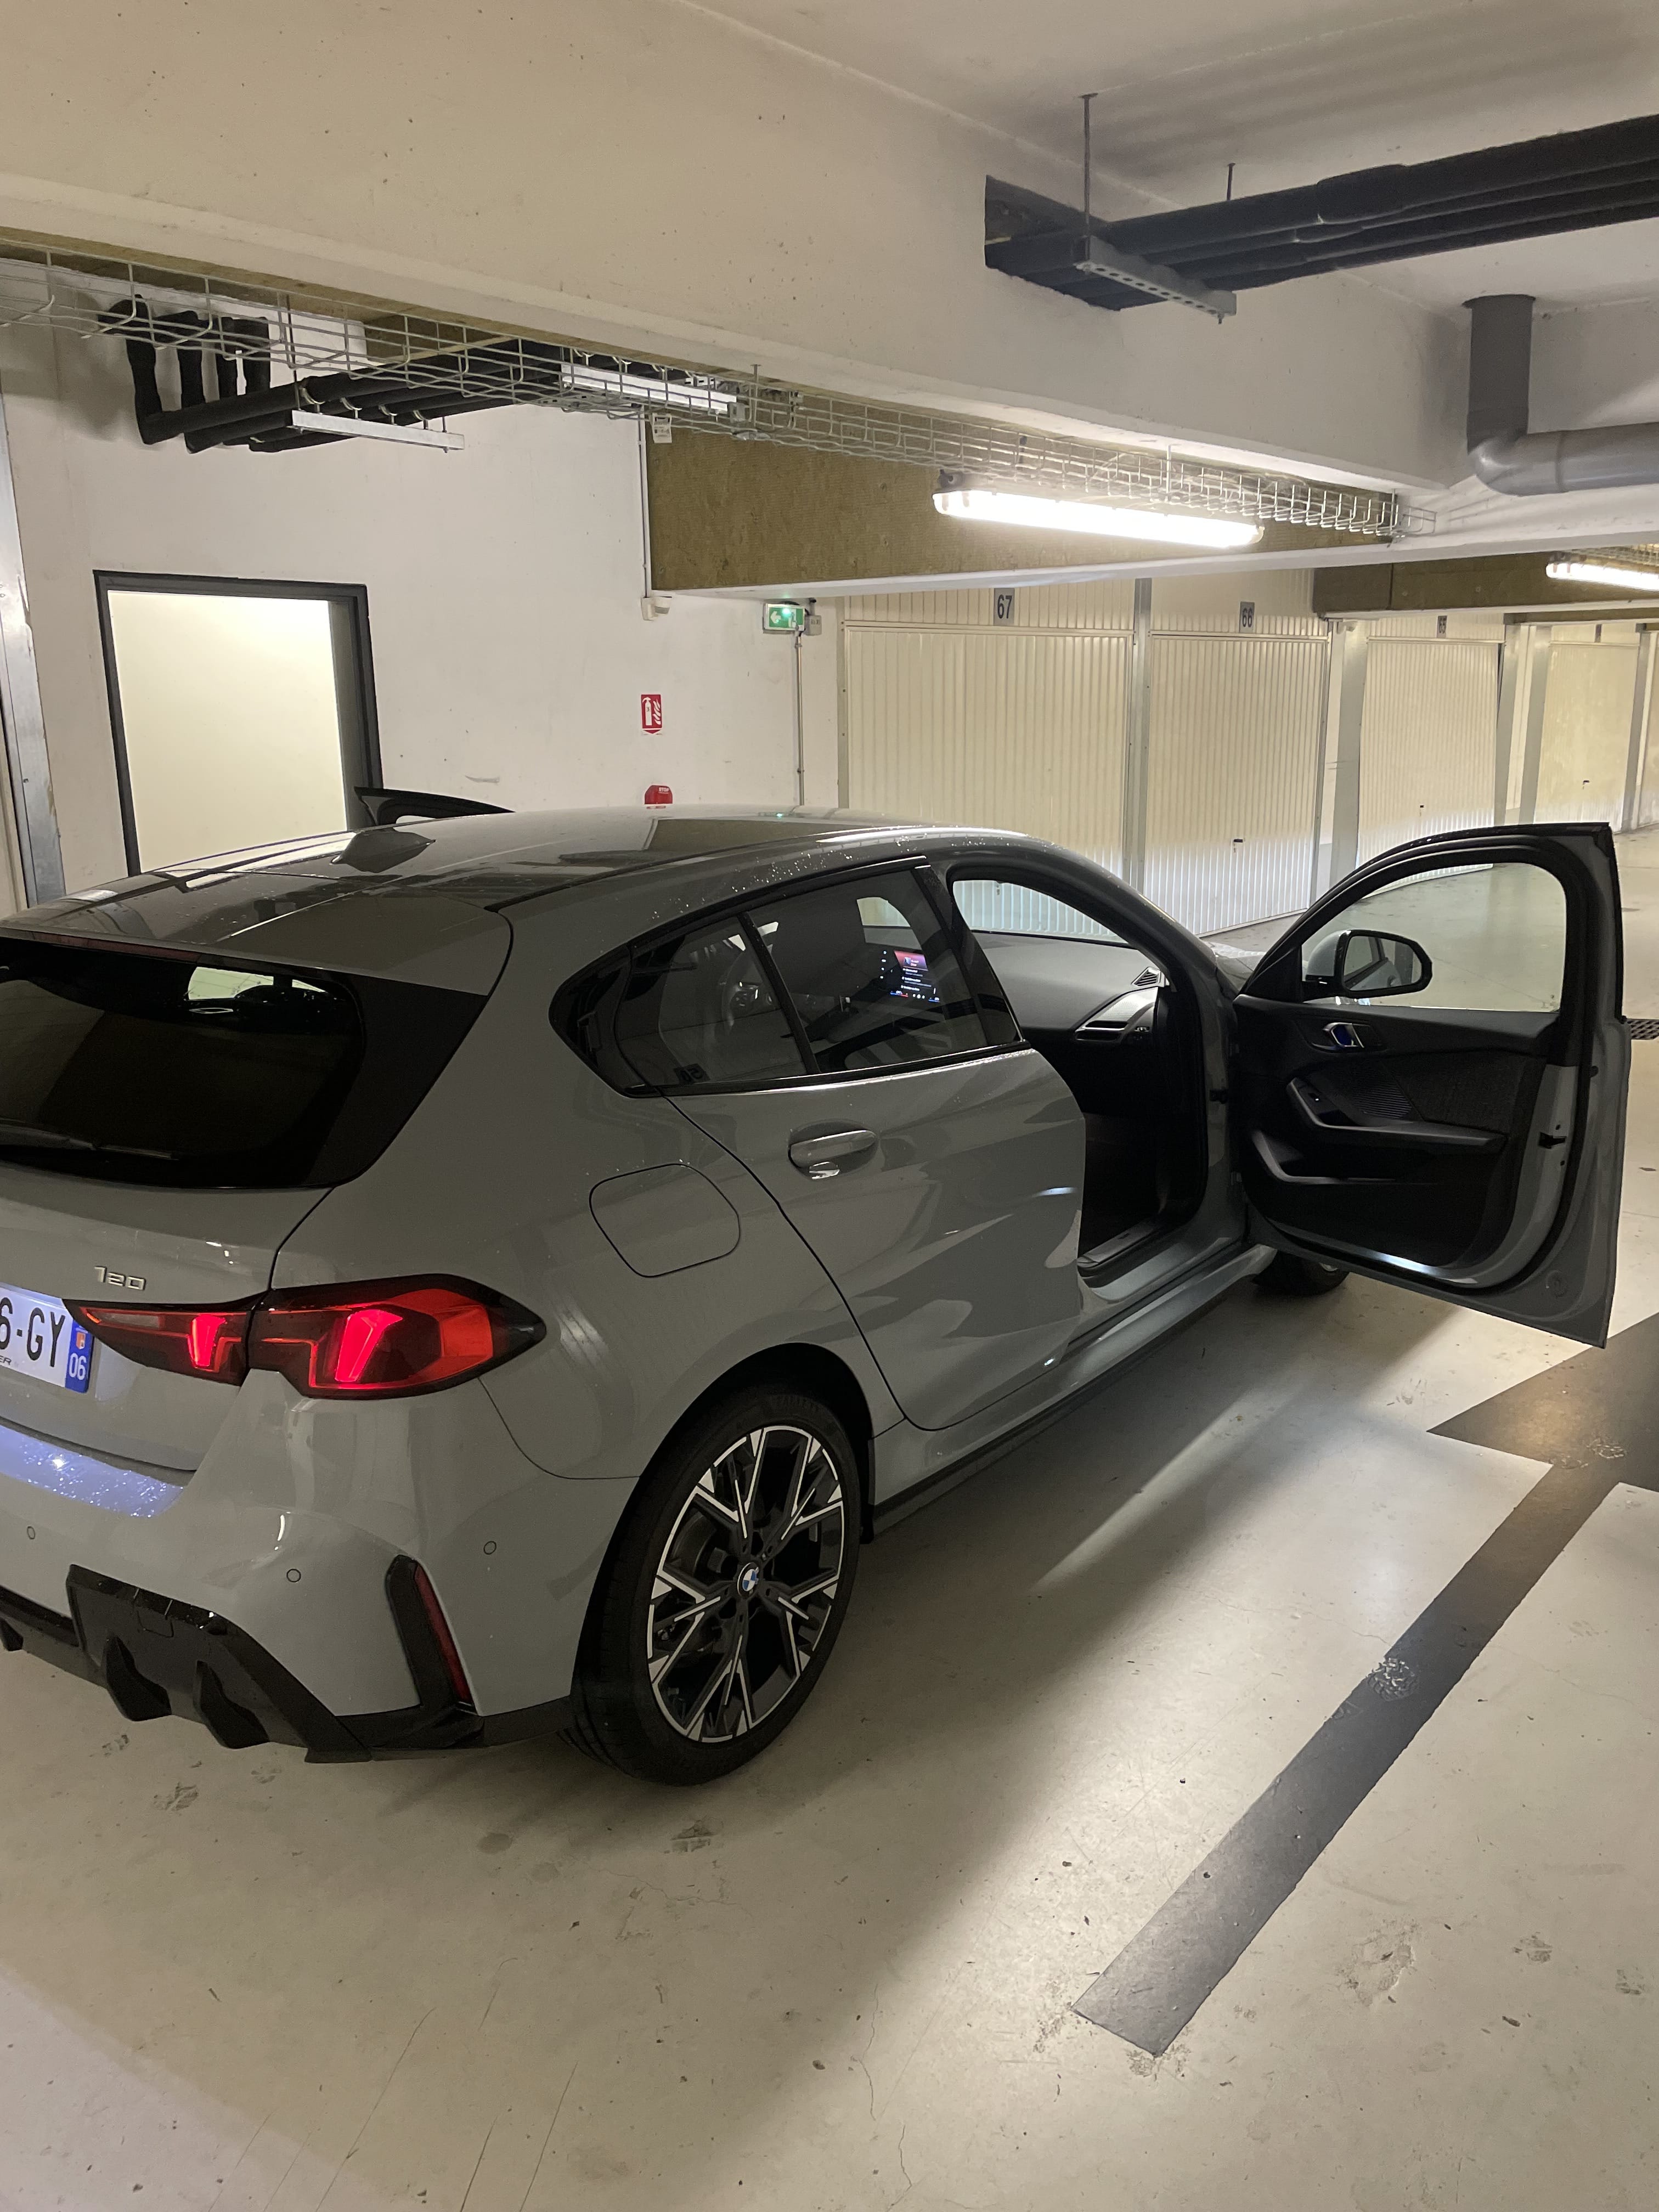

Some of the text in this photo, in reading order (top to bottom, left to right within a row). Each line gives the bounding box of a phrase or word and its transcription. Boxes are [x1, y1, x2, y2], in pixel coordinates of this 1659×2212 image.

[997, 594, 1012, 619] 67
[1242, 608, 1252, 628] 66
[94, 1266, 146, 1290] 120
[69, 1352, 87, 1380] 06
